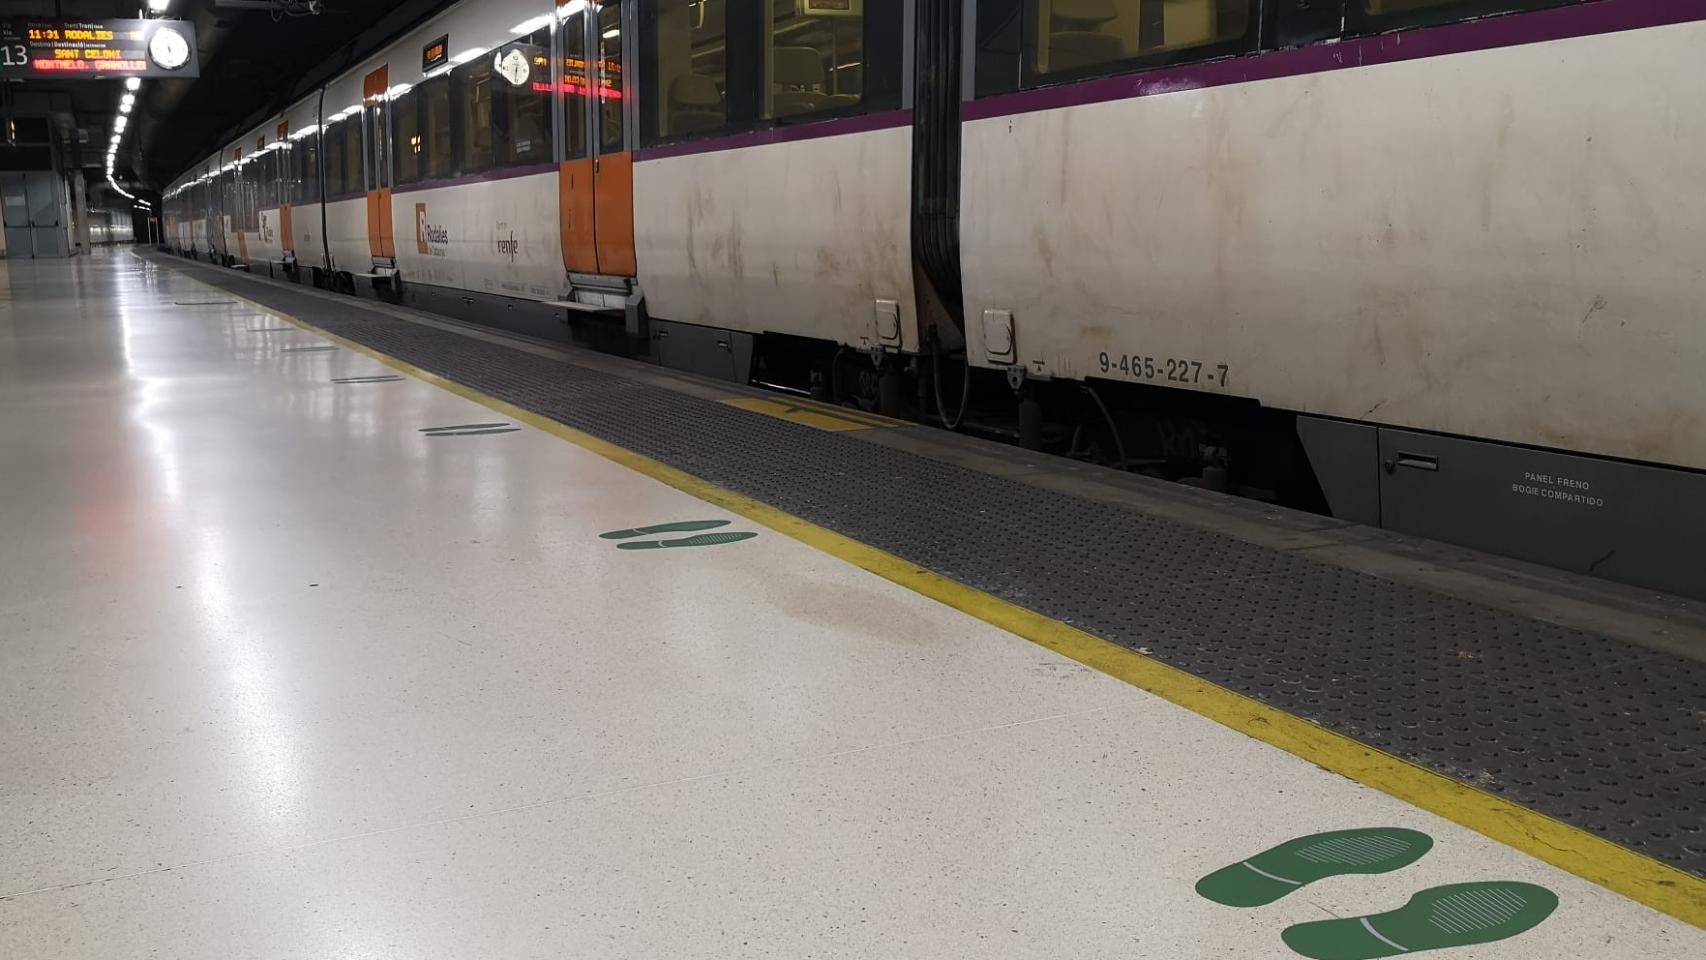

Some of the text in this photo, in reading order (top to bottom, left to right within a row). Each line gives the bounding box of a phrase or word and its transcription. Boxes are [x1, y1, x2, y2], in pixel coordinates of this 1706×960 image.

[28, 30, 60, 39] 11:31
[64, 30, 114, 40] RODALIES
[0, 45, 28, 66] 13
[54, 49, 121, 59] SANT CELONI
[427, 224, 448, 244] Rodalies
[497, 230, 519, 263] renfe
[1099, 351, 1229, 388] 9-465-227-7
[1525, 472, 1589, 490] PANEL FRENO
[1512, 484, 1603, 506] BOGIE COMPARTIDO
